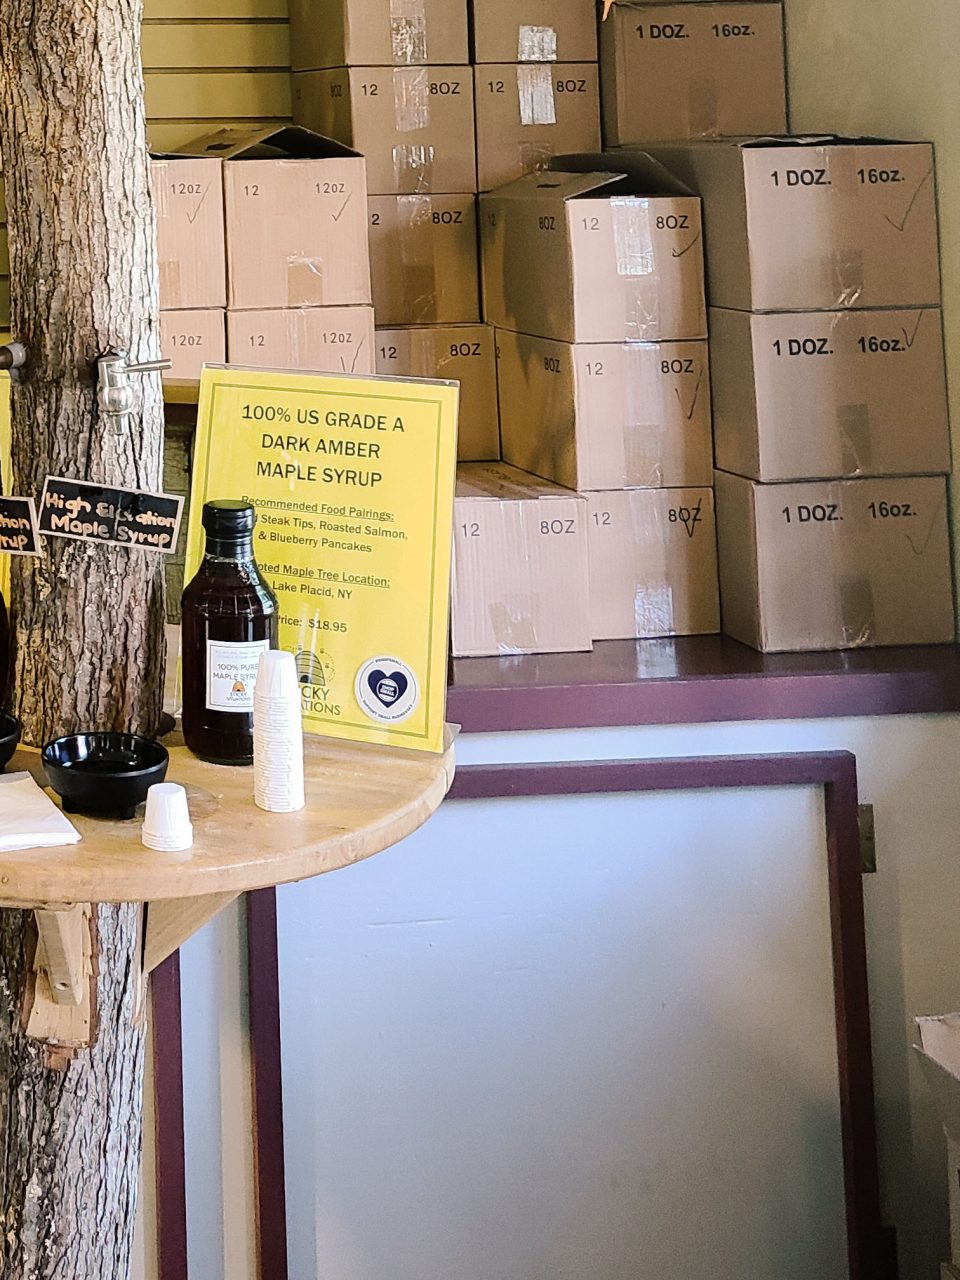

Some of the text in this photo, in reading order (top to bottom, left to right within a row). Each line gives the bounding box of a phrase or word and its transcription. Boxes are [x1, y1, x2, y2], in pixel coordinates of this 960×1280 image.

[636, 24, 755, 39] 1 DOZ. 16oz.
[362, 82, 460, 96] 12 8OZ
[488, 80, 586, 93] 12 8OZ
[771, 168, 906, 186] 1 DOZ. 16oz.
[244, 185, 259, 196] 12
[432, 211, 462, 224] 8OZ
[582, 215, 689, 230] 12 8OZ
[250, 335, 265, 347] 12
[773, 336, 906, 356] 1 DOZ. 16oz.
[380, 343, 481, 359] 12 8OZ
[586, 360, 693, 376] 12 8OZ
[242, 404, 405, 432] 100% US GRADE A
[261, 434, 380, 458] DARK AMBER
[256, 461, 382, 488] MAPLE SYRUP
[46, 492, 176, 529] High Elevation
[242, 496, 394, 522] Recommended Food Pairings:
[782, 501, 917, 523] 1 DOZ. 16oz.
[261, 514, 290, 526] Steak
[294, 518, 316, 530] Tips,
[320, 520, 362, 534] Roasted
[364, 526, 408, 540] Salmon,
[592, 512, 611, 526] 12
[51, 513, 170, 547] Maple Syrup
[461, 520, 575, 538] 12 8OZ
[258, 531, 372, 552] & Blueberry Pancakes
[283, 565, 314, 578] Maple
[317, 568, 339, 580] Tree
[342, 571, 390, 587] Location:
[272, 580, 352, 599] Lake Placid, NY
[308, 618, 348, 633] $18.95
[213, 672, 238, 681] MAPLE
[302, 686, 330, 701] CKY
